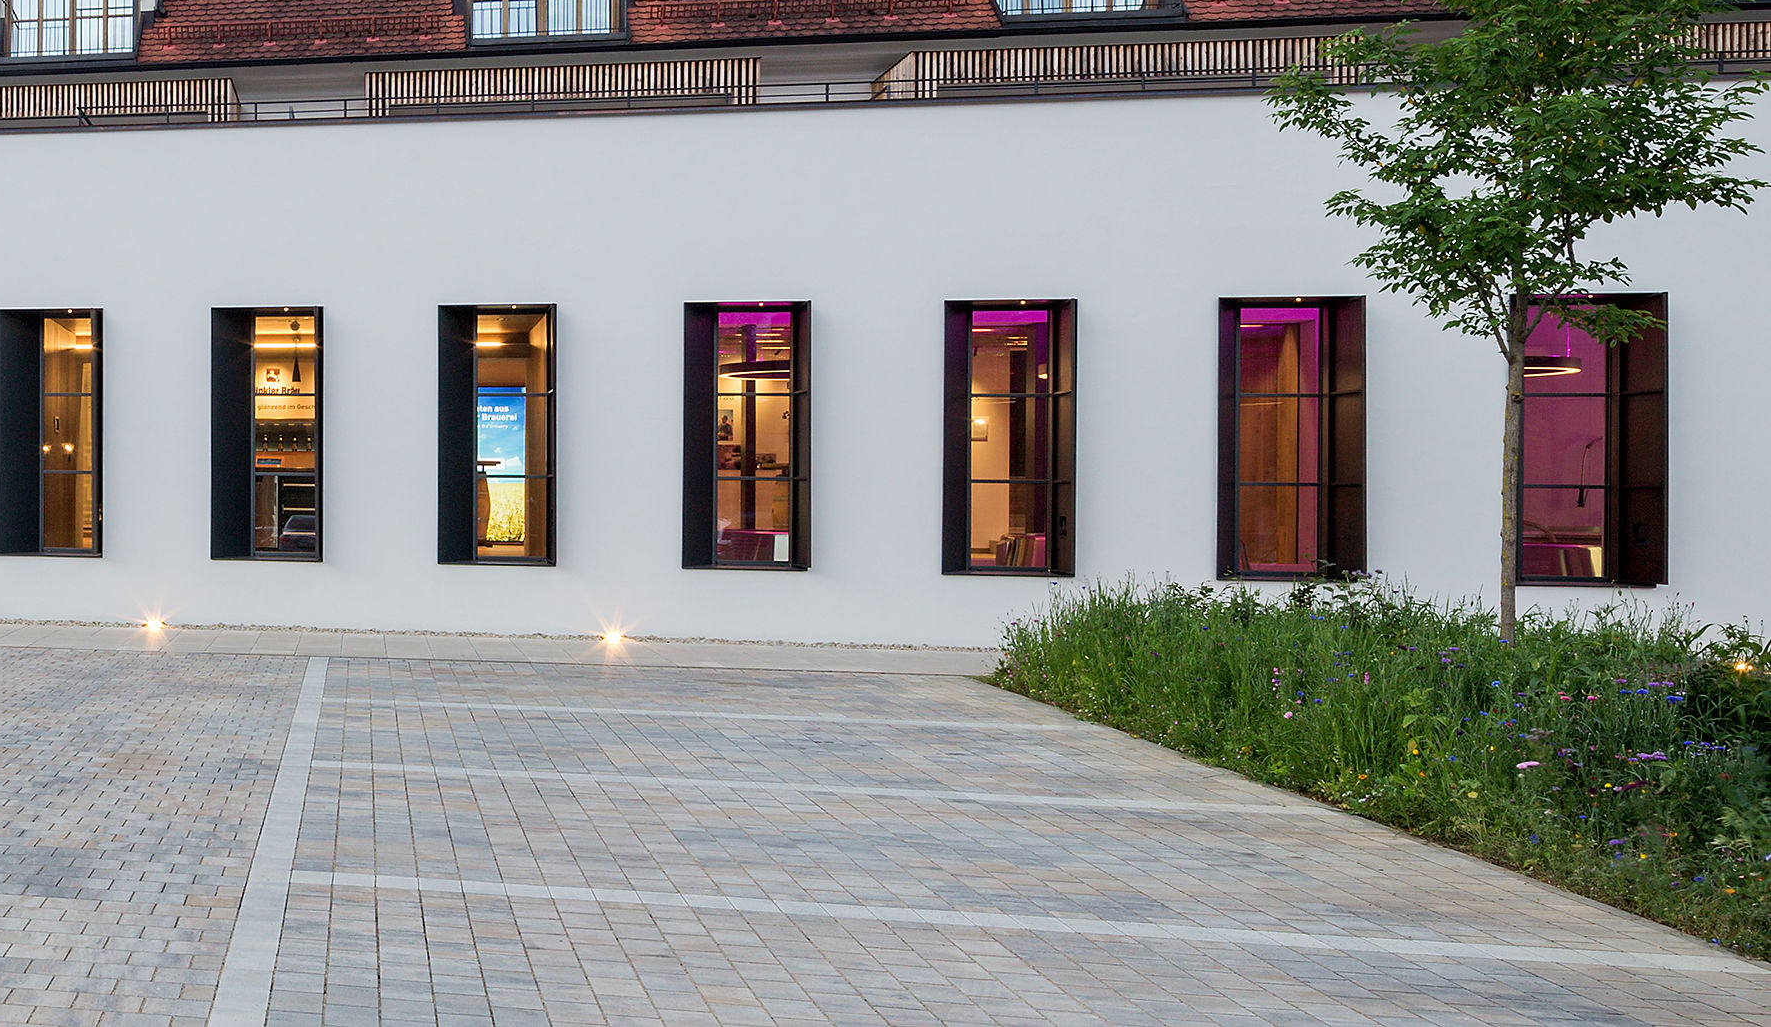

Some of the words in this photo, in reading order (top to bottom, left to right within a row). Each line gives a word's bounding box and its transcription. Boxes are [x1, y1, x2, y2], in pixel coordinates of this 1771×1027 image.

[255, 386, 279, 394] inkler
[281, 386, 300, 394] Bräu
[481, 413, 517, 421] Brauerei
